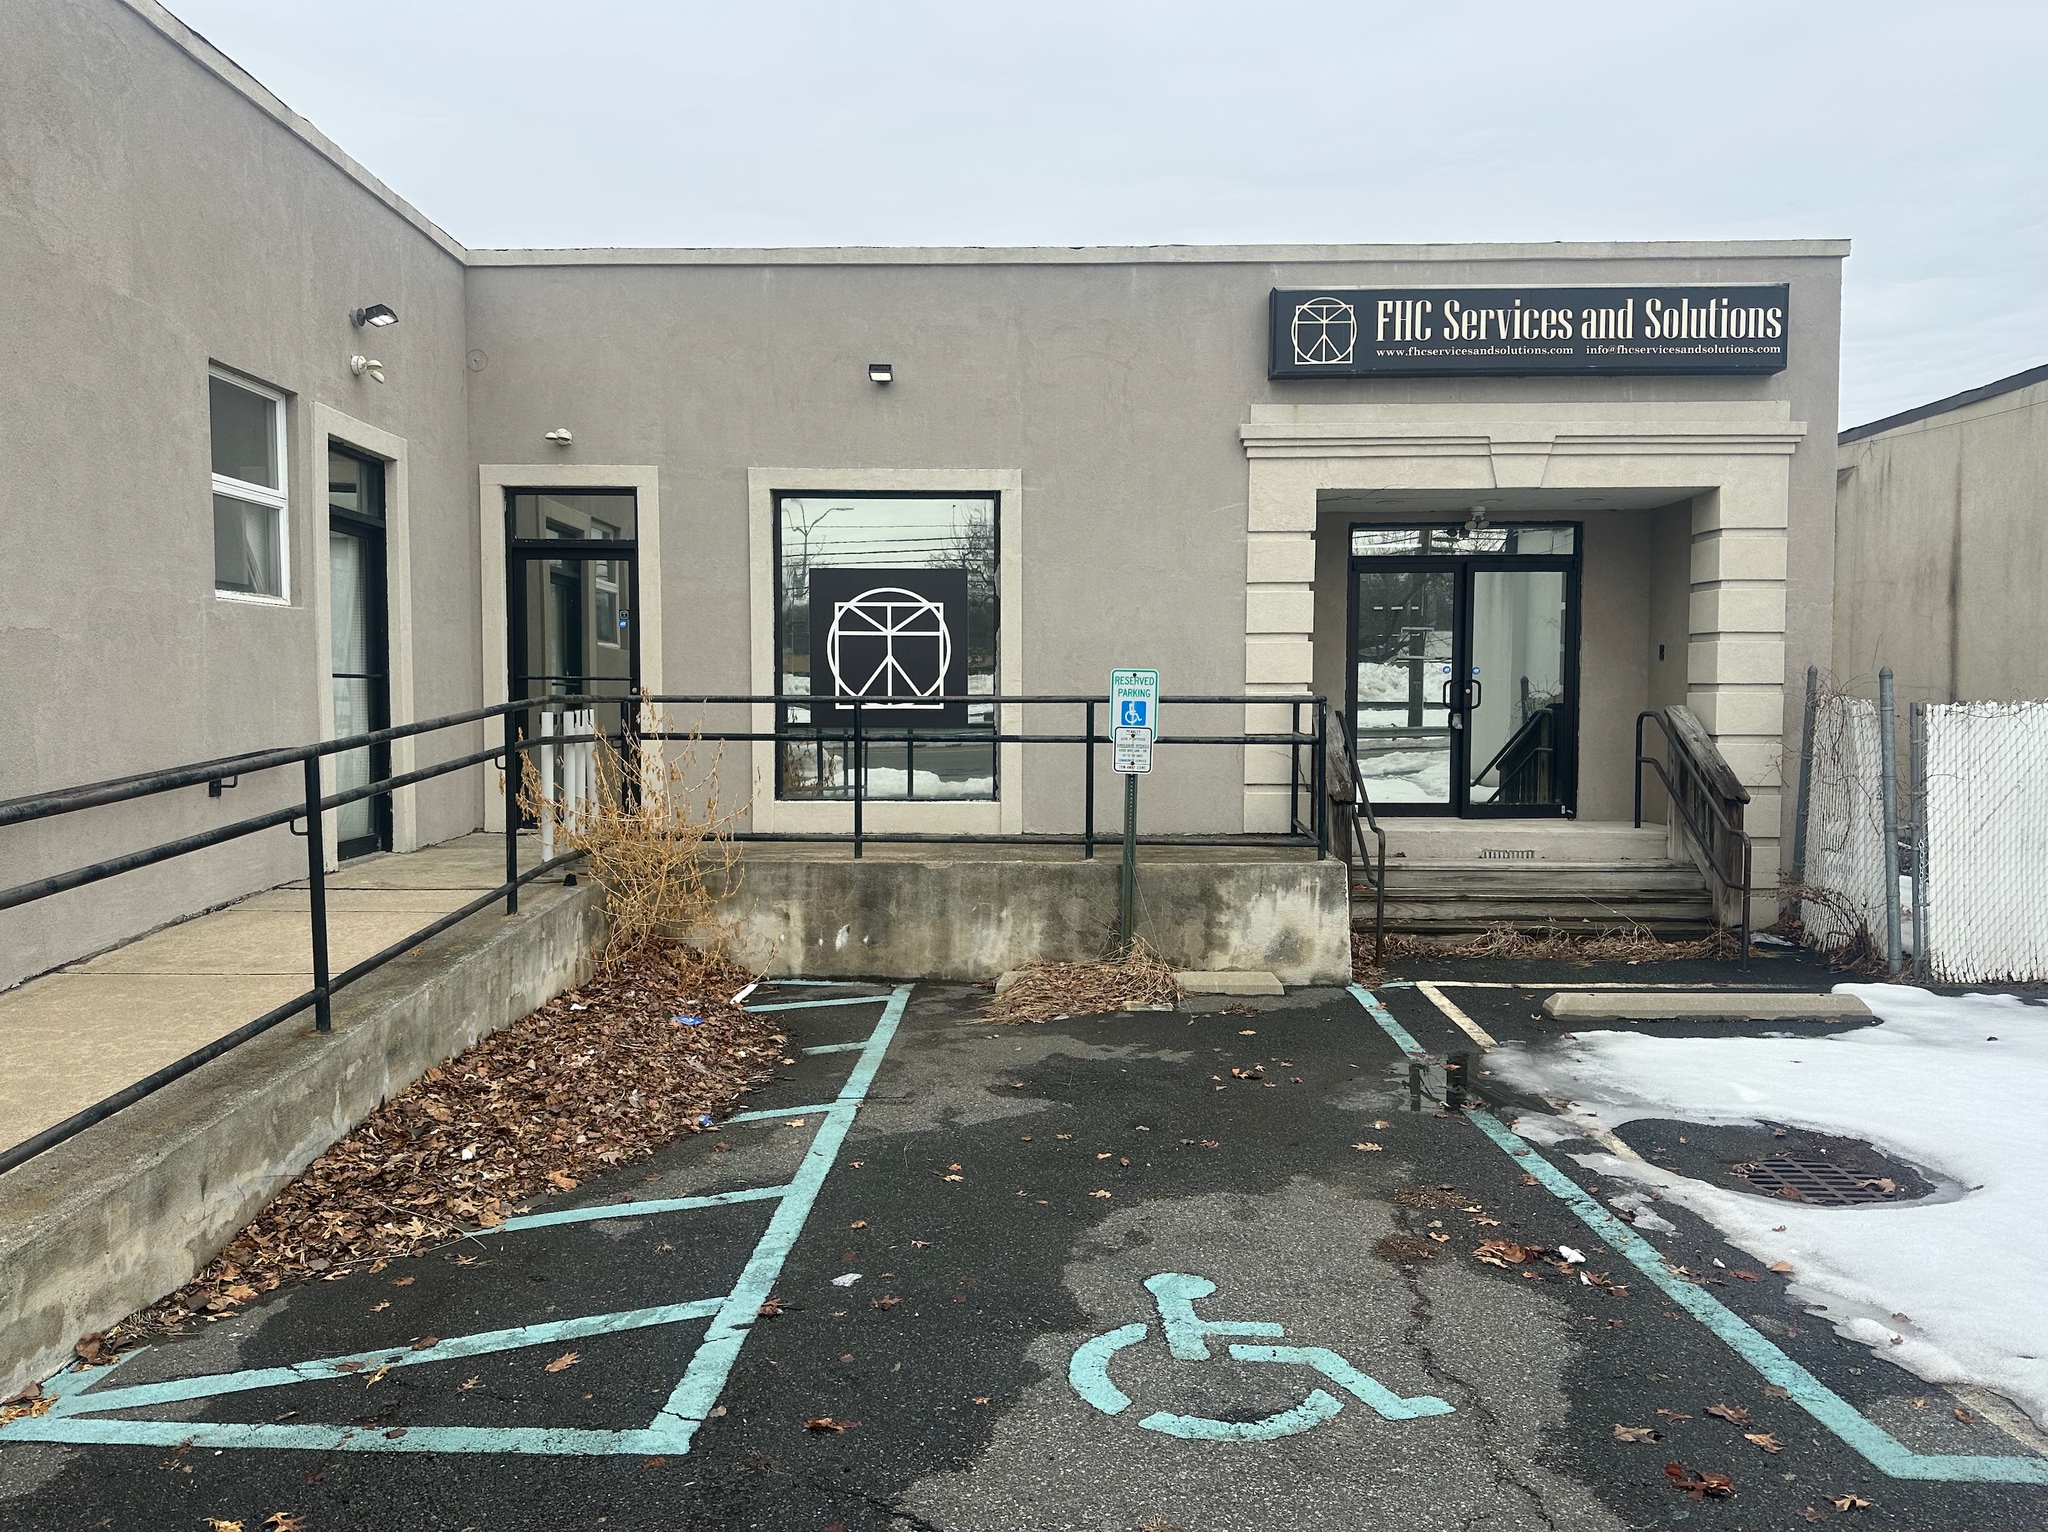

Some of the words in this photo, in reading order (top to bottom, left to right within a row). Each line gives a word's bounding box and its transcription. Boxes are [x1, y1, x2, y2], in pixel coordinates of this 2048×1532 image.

[1376, 299, 1433, 341] FHC
[1442, 298, 1573, 341] Services
[1581, 298, 1634, 340] and
[1644, 297, 1783, 340] Solutions
[1376, 345, 1574, 357] www.fhcservicesandsolutions.com
[1586, 344, 1781, 355] info@fhcservicesandsolutions.com
[1115, 676, 1155, 686] RESERVED
[1117, 688, 1151, 698] PARKING
